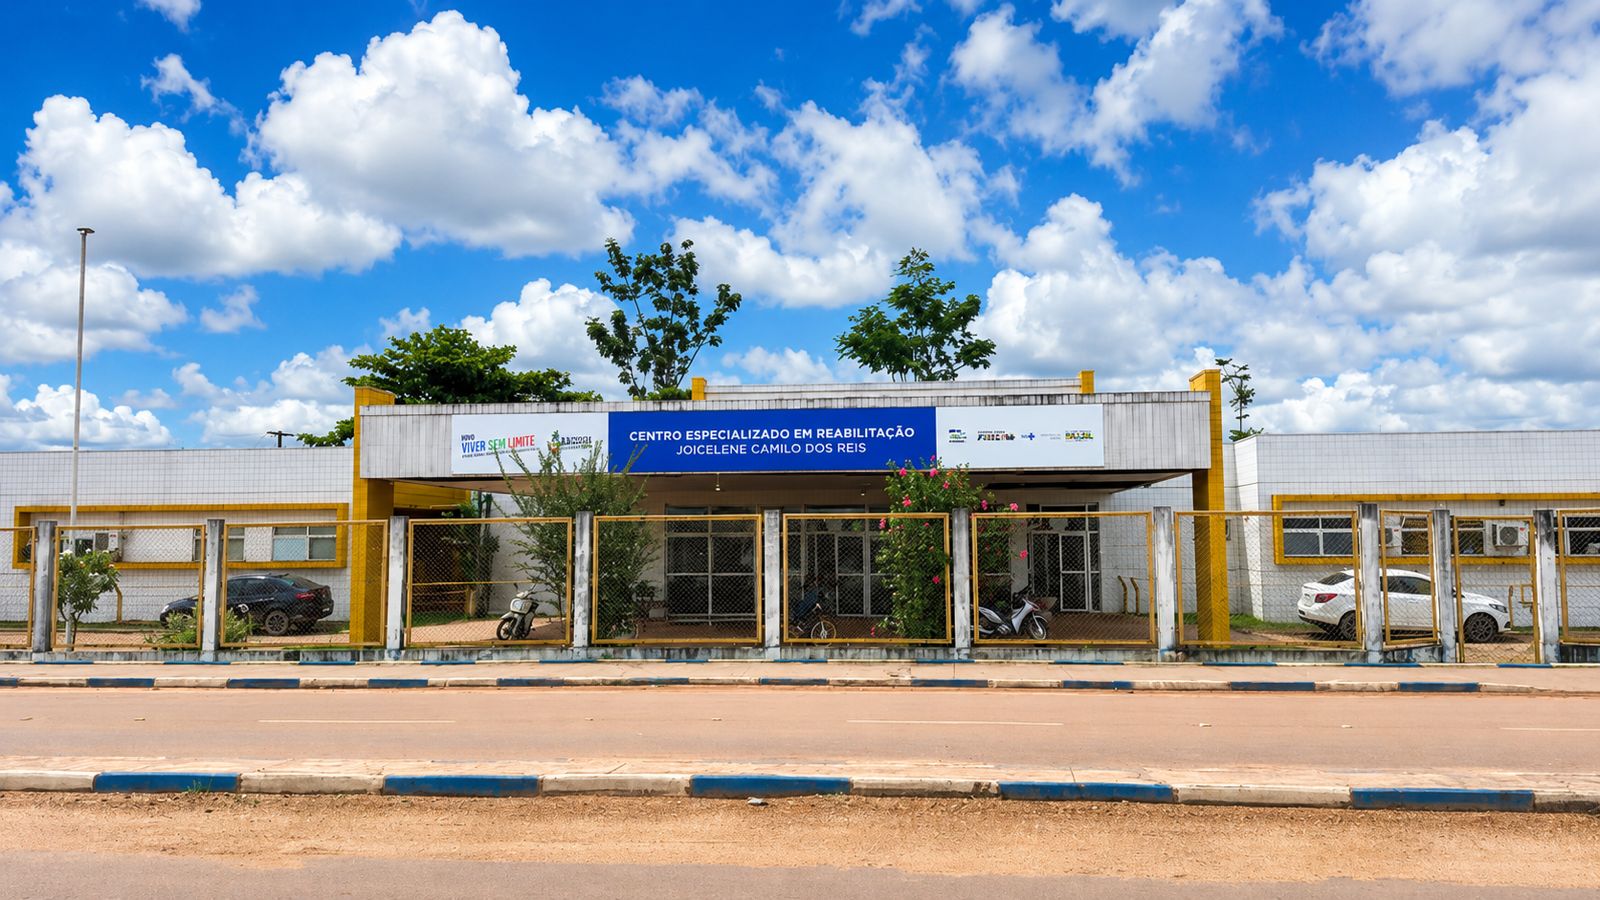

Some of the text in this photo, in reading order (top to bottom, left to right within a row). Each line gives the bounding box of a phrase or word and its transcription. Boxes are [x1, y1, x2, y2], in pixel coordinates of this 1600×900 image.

[629, 425, 915, 441] CENTRO ESPECIALIZADO EM REABILITAÇÃO
[461, 441, 486, 453] VIVER
[488, 437, 506, 451] SEM
[507, 434, 535, 449] LIMITE
[676, 442, 867, 455] JOICELENE CAMILO DOS REIS
